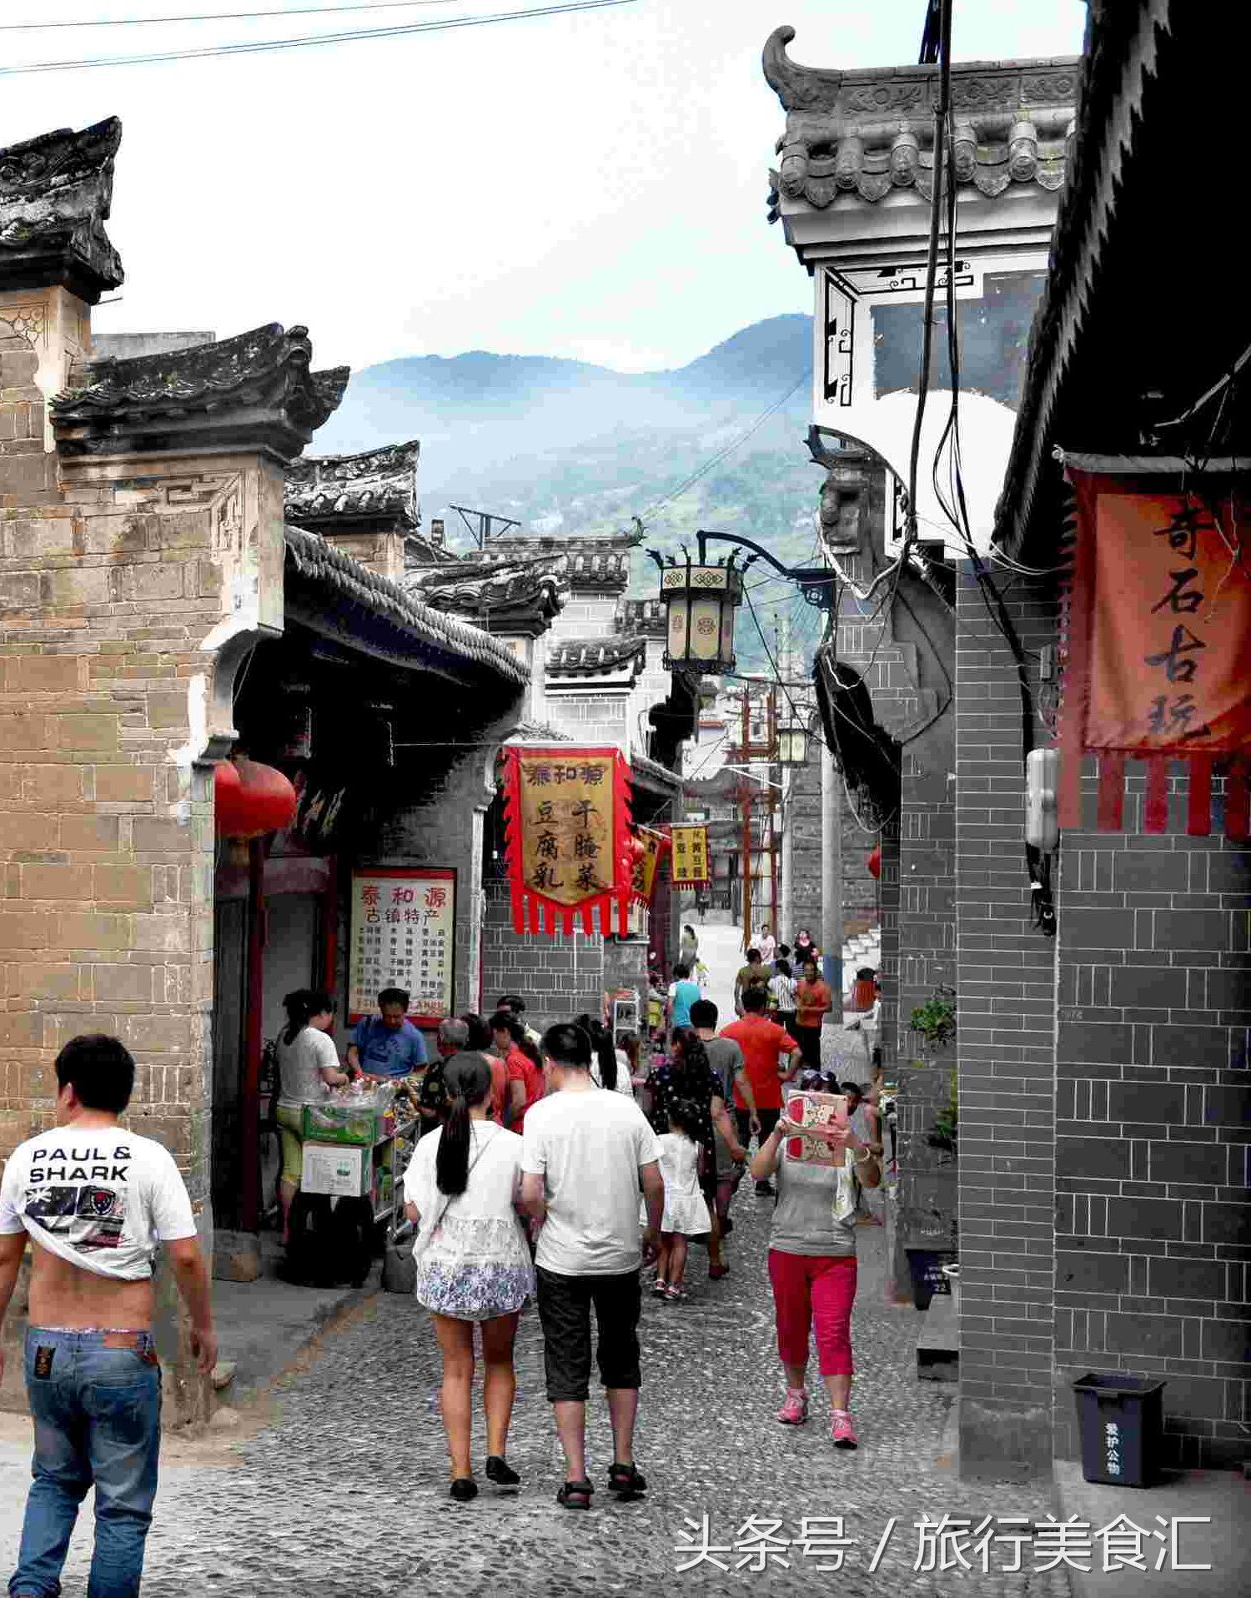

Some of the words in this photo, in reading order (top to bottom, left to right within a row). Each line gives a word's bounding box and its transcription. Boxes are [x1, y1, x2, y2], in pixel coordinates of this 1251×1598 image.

[1144, 506, 1215, 738] 奇石古玩
[530, 800, 564, 890] 豆腐乳
[361, 885, 447, 908] 泰和源
[366, 908, 440, 926] 古镇特产
[32, 1147, 107, 1162] PAUL
[113, 1146, 132, 1160] &
[29, 1165, 130, 1183] SHARK
